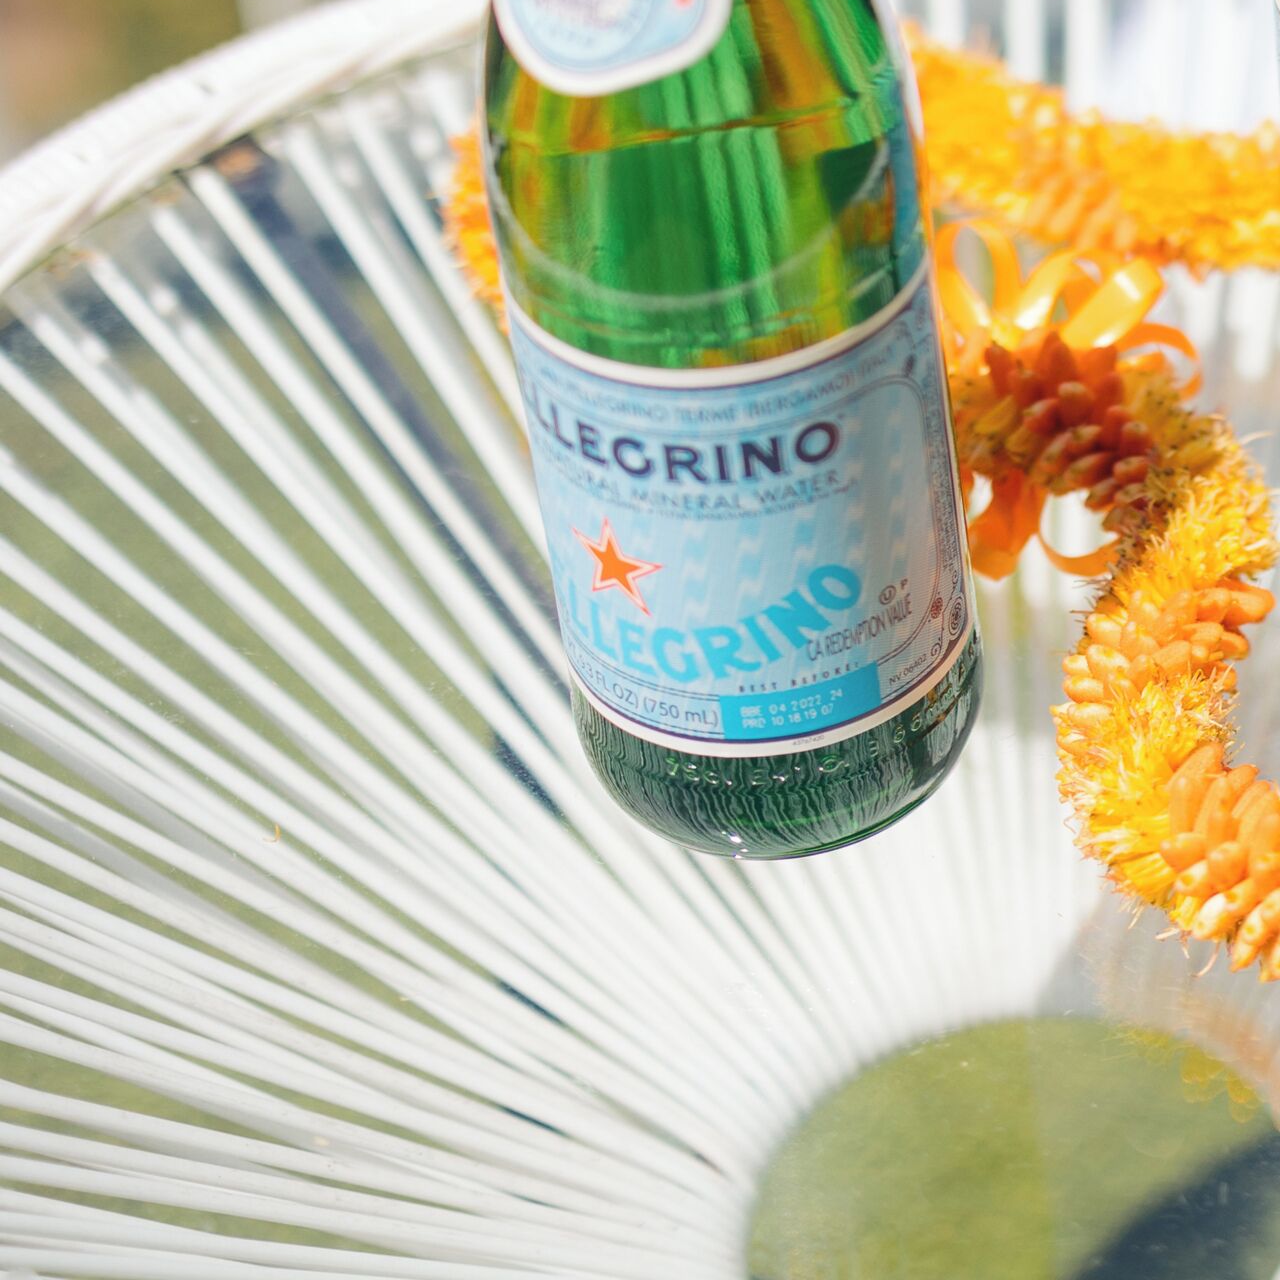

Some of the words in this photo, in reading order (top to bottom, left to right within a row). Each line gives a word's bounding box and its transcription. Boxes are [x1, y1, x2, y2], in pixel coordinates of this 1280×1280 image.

[562, 564, 862, 683] LLEGRINO
[825, 611, 887, 657] REDEMPTION
[613, 682, 639, 710] OZ)
[643, 696, 680, 719] (750
[685, 709, 719, 728] mL)
[739, 681, 777, 693] BEST
